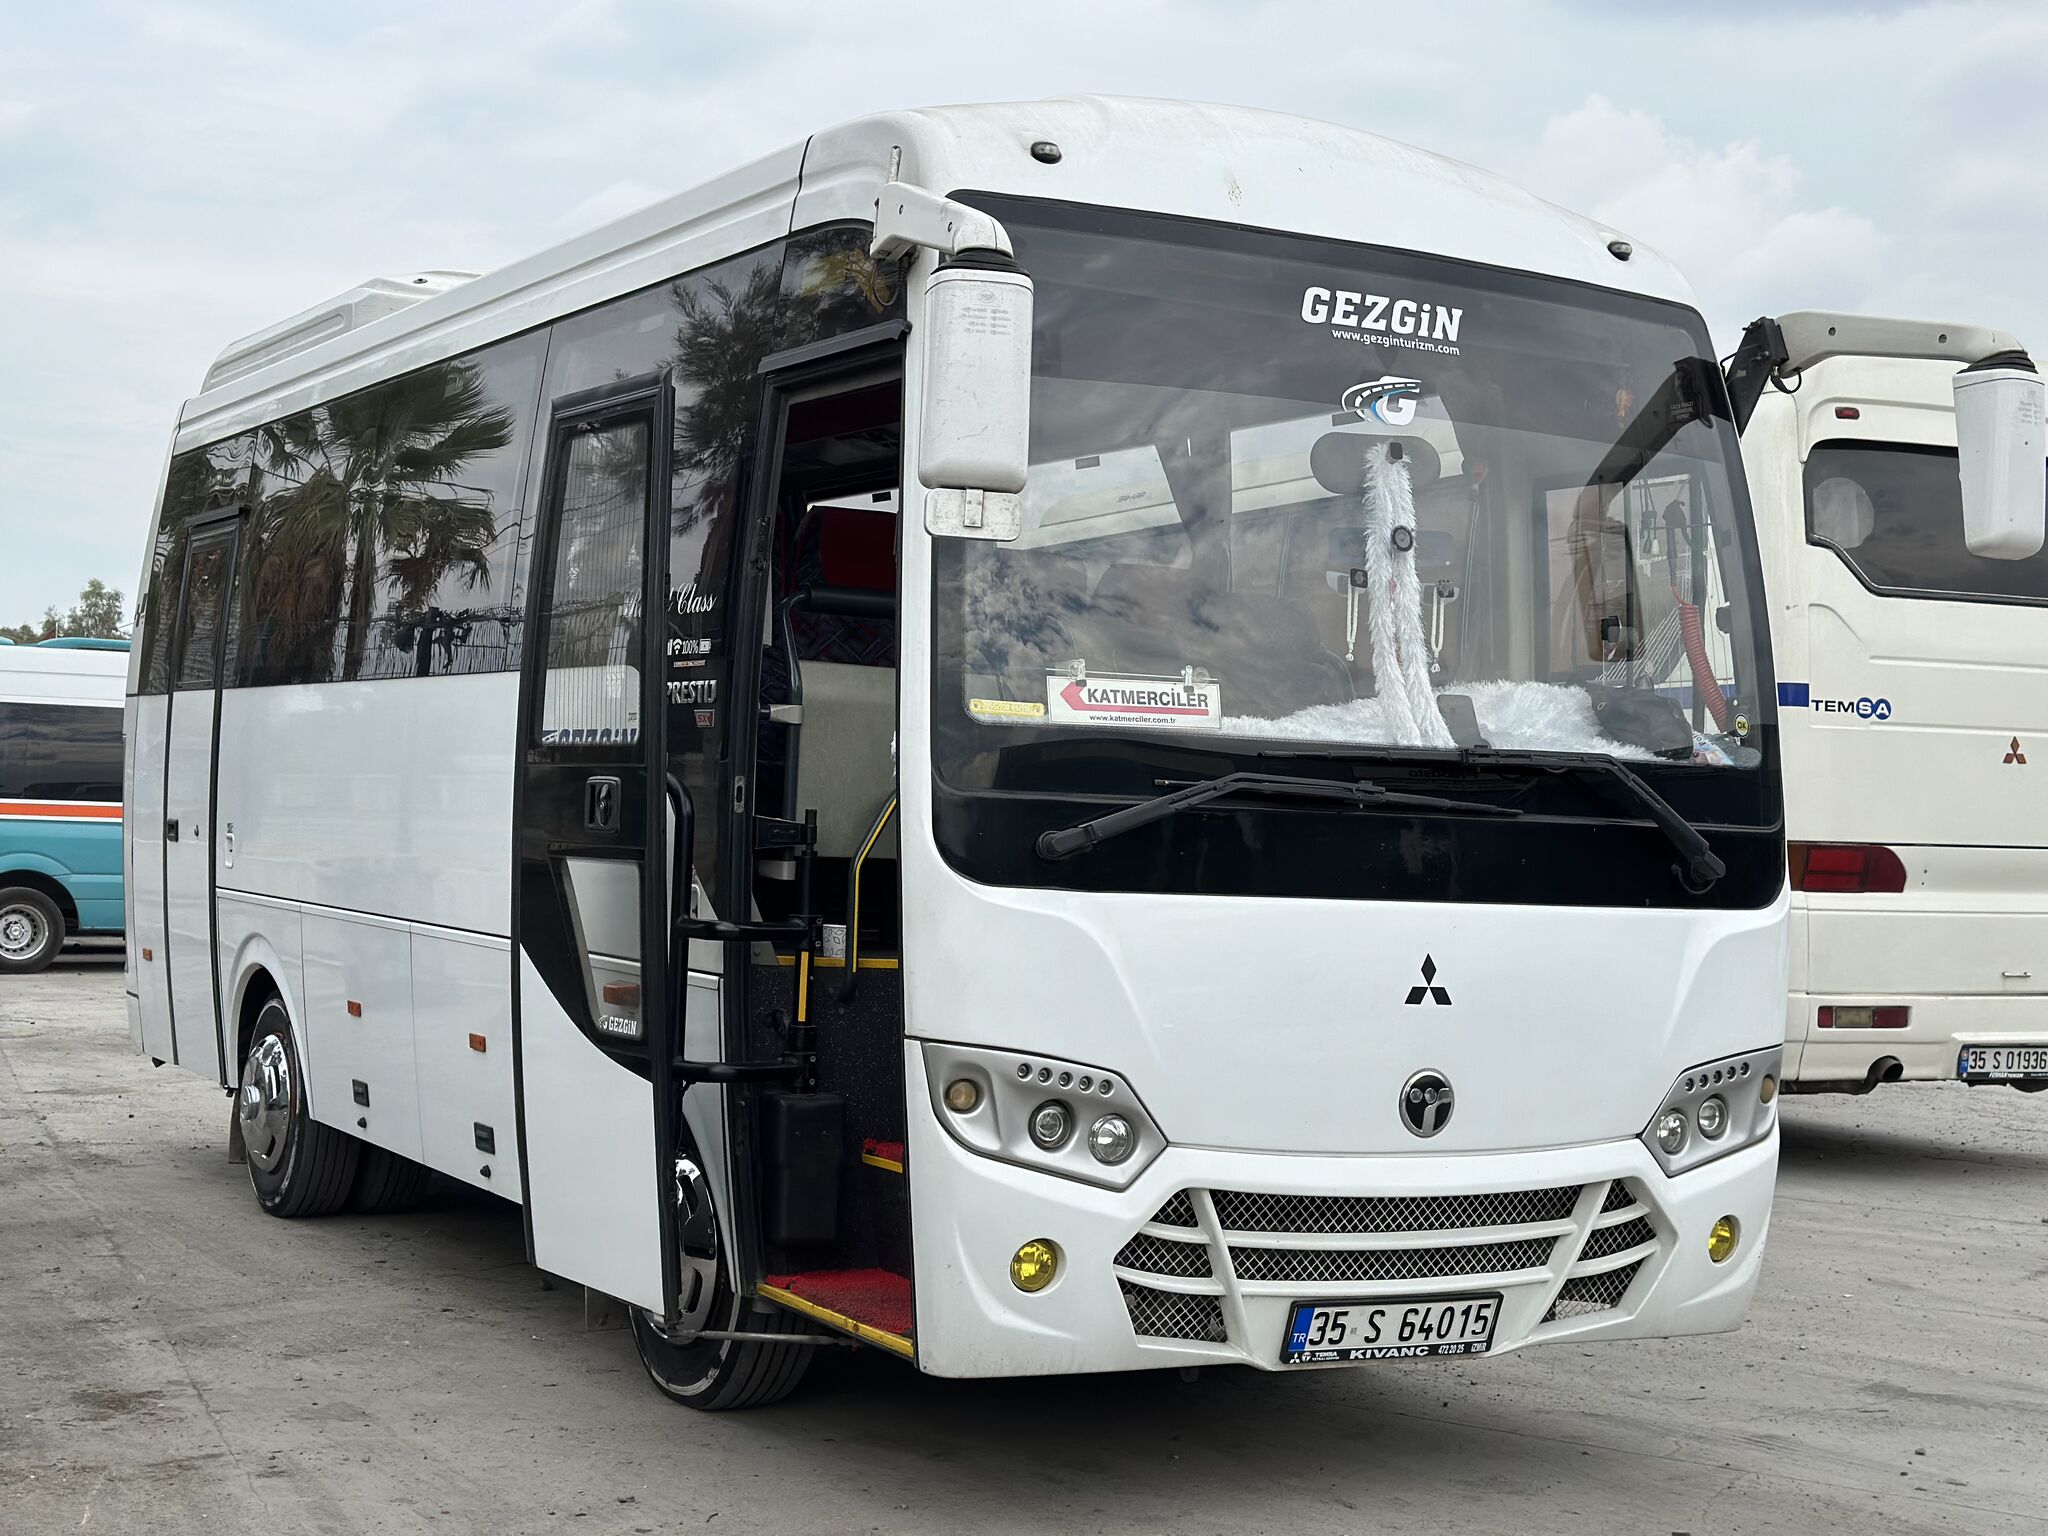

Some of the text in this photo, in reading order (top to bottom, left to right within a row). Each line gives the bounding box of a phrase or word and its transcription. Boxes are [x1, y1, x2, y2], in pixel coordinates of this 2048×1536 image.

[1332, 329, 1460, 355] www.gezginturizm.com
[677, 583, 717, 614] Class
[1087, 688, 1209, 708] KATMERCİLER
[1811, 697, 1892, 720] TEMSA
[1089, 714, 1176, 724] www.katmerciler.com.tr
[1737, 721, 1747, 730] OK
[1969, 1051, 2048, 1069] 35 S 01936
[1293, 1303, 1492, 1345] TR 35 S 64015
